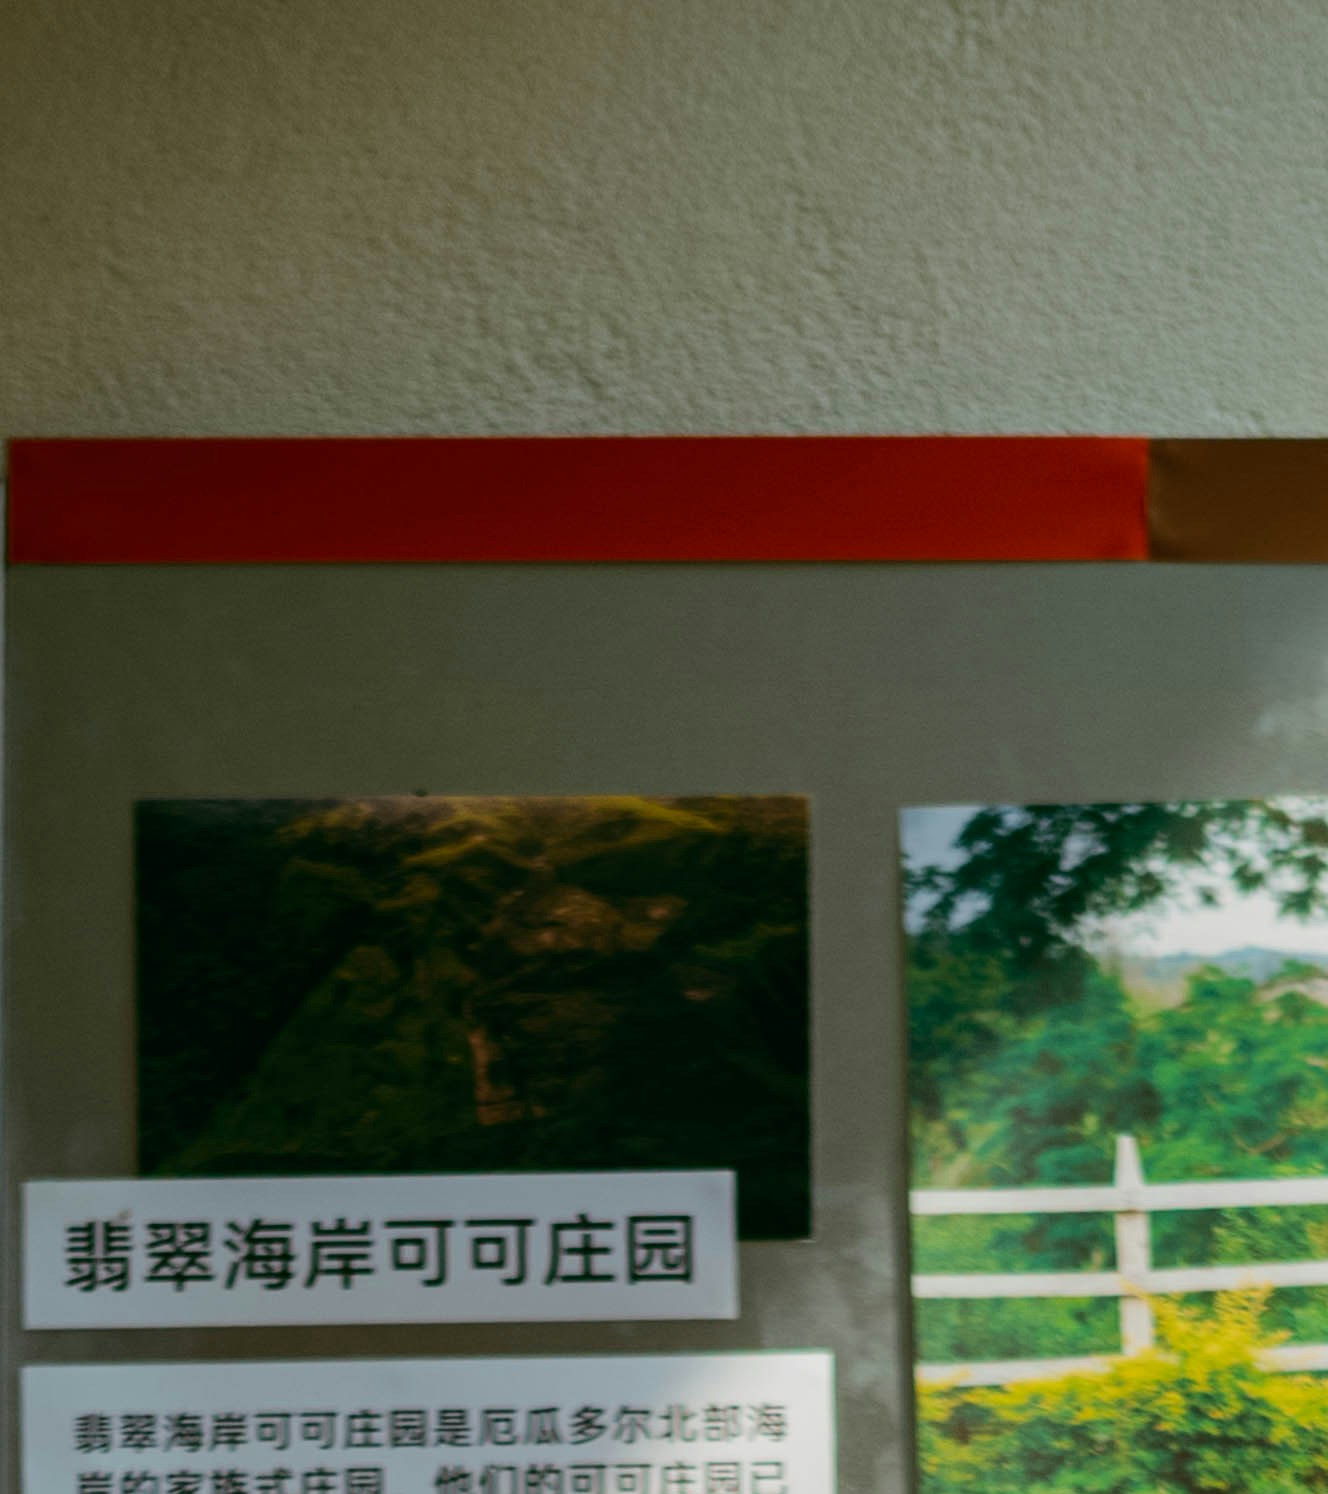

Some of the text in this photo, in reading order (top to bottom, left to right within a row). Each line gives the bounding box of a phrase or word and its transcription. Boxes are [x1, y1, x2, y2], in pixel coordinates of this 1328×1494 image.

[63, 1212, 696, 1294] 翡翠海岸可可庄园
[72, 1401, 790, 1455] 翡翠海岸可可庄园是厄瓜多尔北部海
